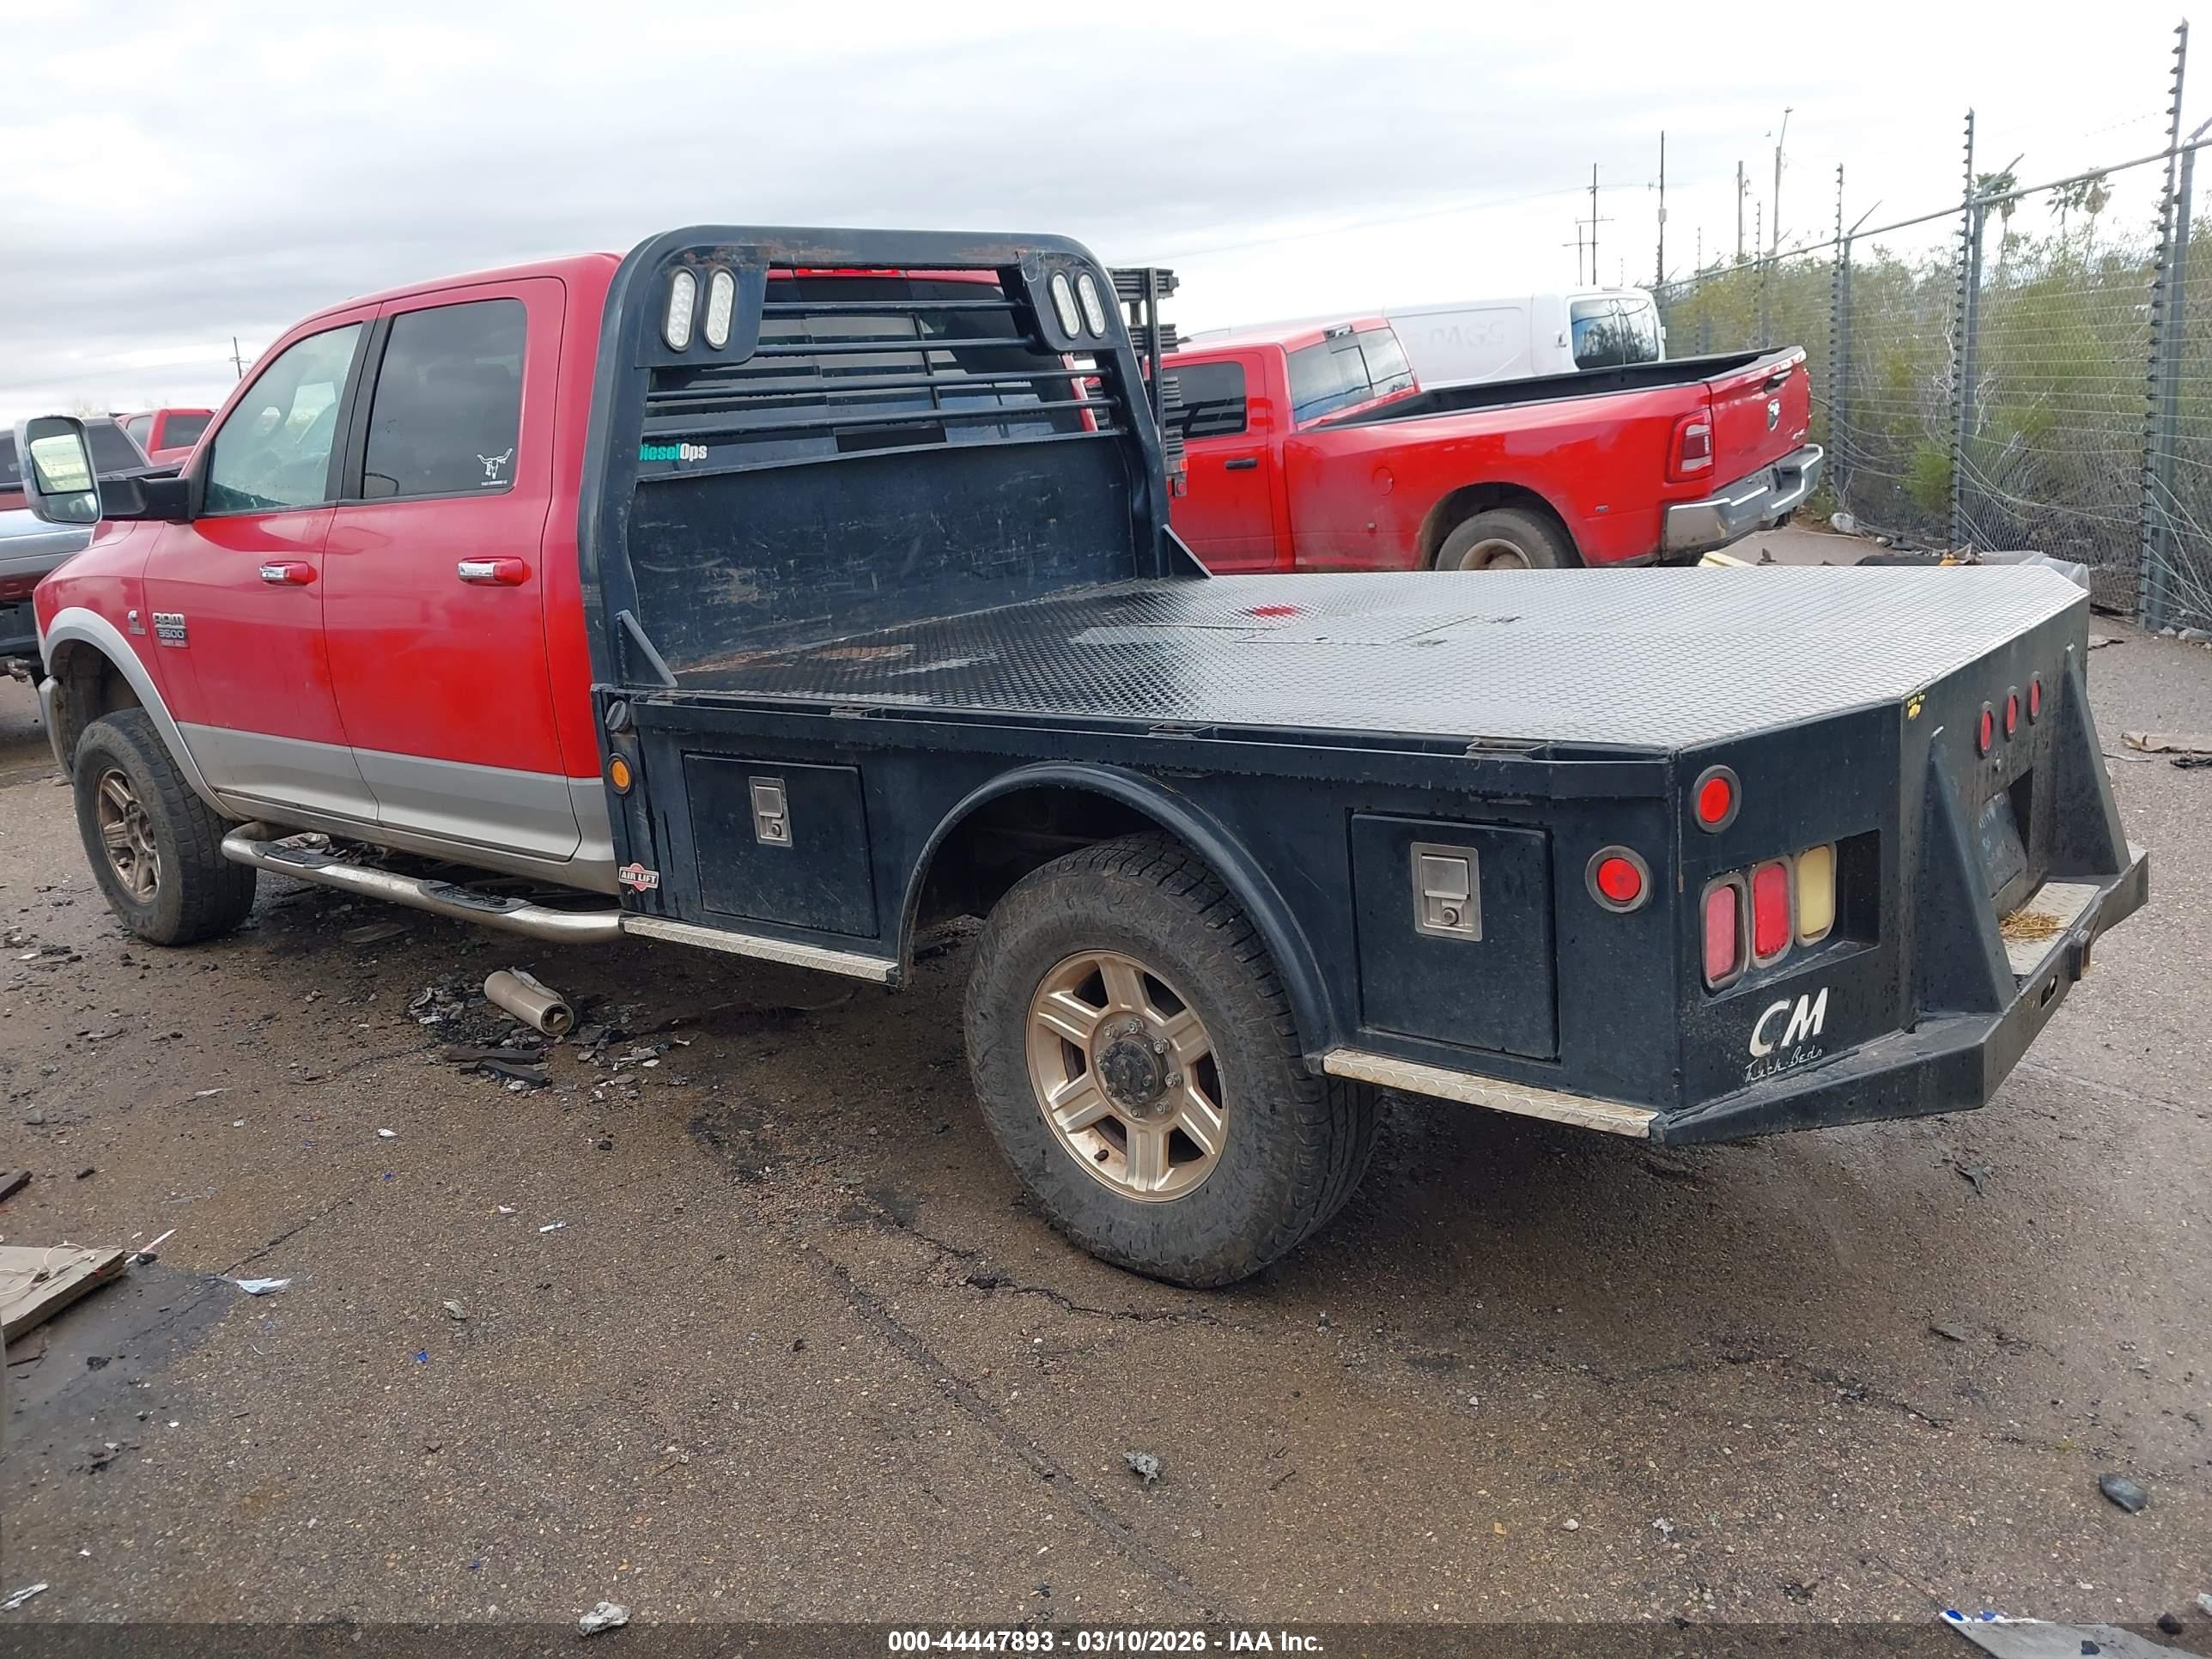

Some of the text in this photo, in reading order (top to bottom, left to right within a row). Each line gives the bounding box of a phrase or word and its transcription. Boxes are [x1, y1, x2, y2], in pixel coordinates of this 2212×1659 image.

[152, 612, 185, 626] RAM
[158, 629, 185, 639] 3500
[621, 871, 657, 884] AIR LIFT
[1749, 988, 1828, 1057] CM
[1788, 1045, 1823, 1067] Beds
